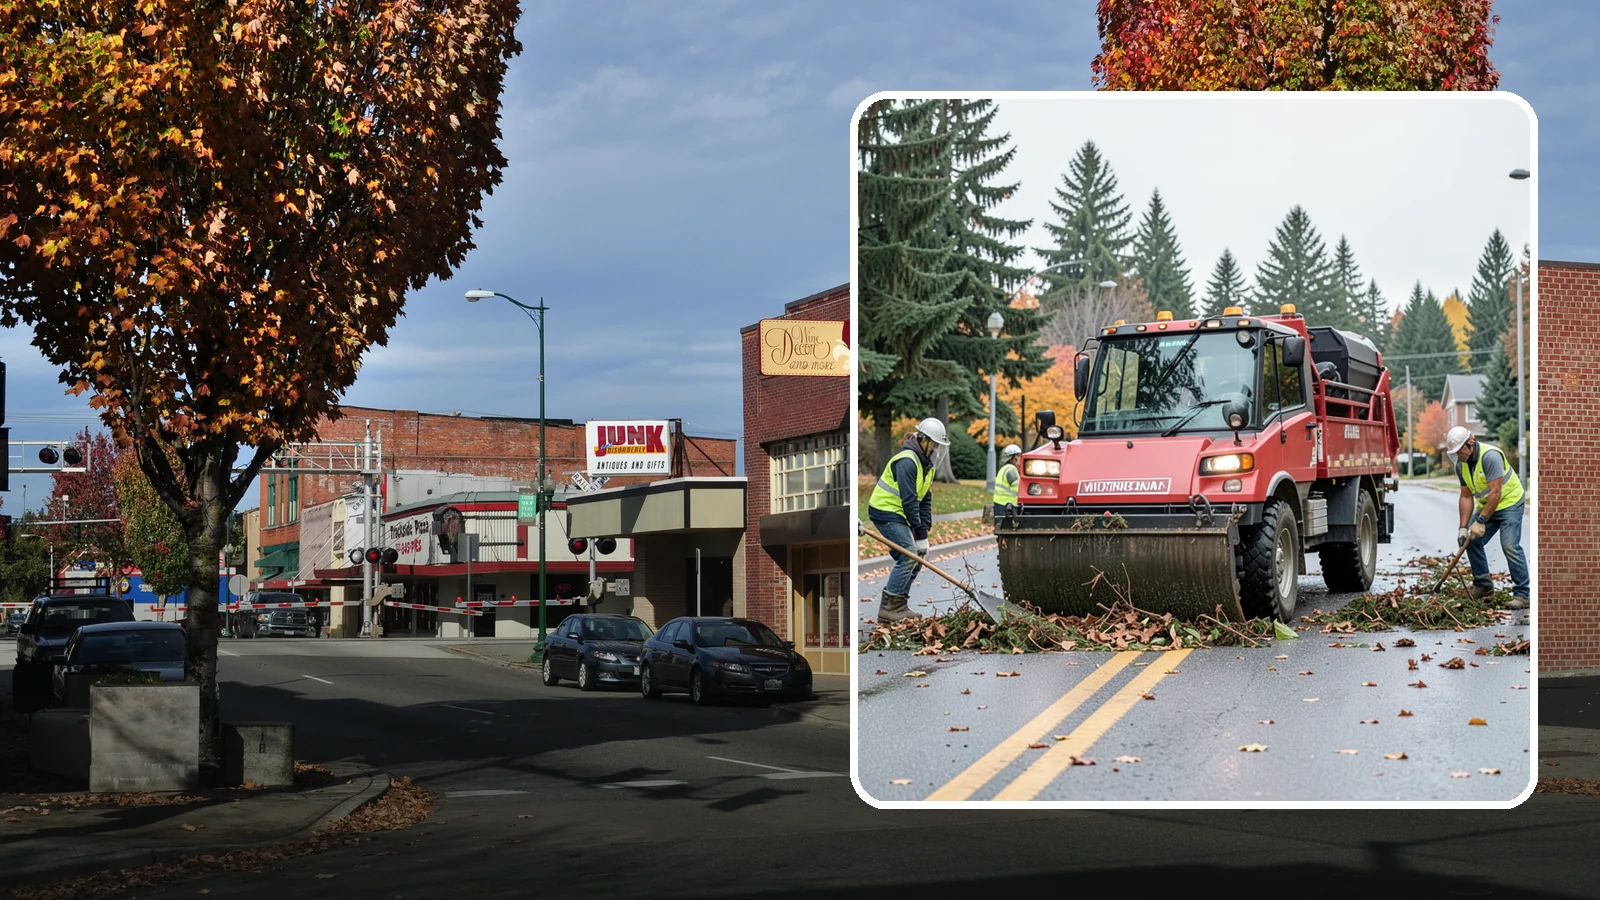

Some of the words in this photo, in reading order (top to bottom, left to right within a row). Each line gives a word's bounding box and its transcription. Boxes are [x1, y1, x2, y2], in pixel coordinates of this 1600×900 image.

[595, 425, 664, 457] JUNK
[607, 446, 646, 454] DISORDERLY
[597, 461, 628, 470] ANTIQUES
[631, 461, 644, 470] AND
[647, 460, 665, 470] GIFTS
[573, 473, 588, 491] RAIL
[390, 520, 413, 539] Trackside
[414, 519, 429, 535] Pizza
